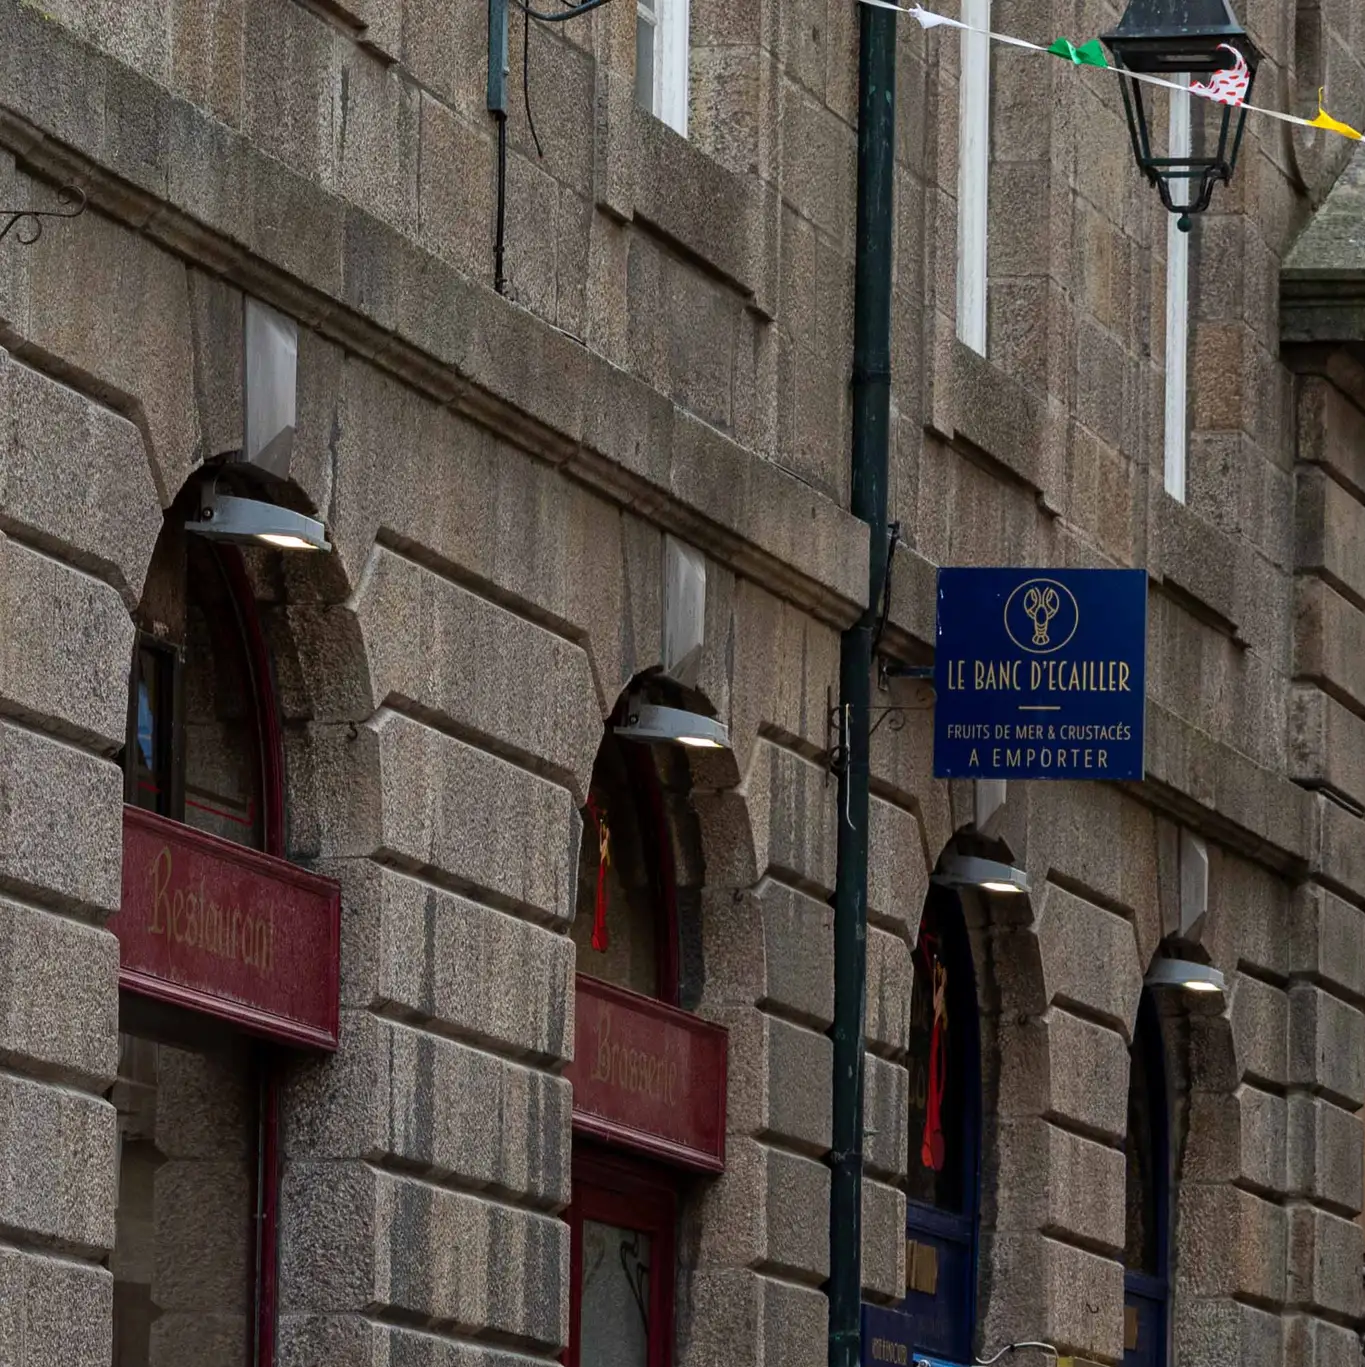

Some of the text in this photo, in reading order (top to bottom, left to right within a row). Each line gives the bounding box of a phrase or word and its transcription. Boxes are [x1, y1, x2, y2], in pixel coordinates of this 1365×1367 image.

[948, 659, 1131, 692] LE BANC D'ECAILLER
[947, 721, 1132, 741] FRUITS DE MER & CRUSTACÉS
[968, 748, 1108, 768] A EMPORTER
[148, 845, 275, 973] Restaurant
[590, 1001, 678, 1107] Brasserie
